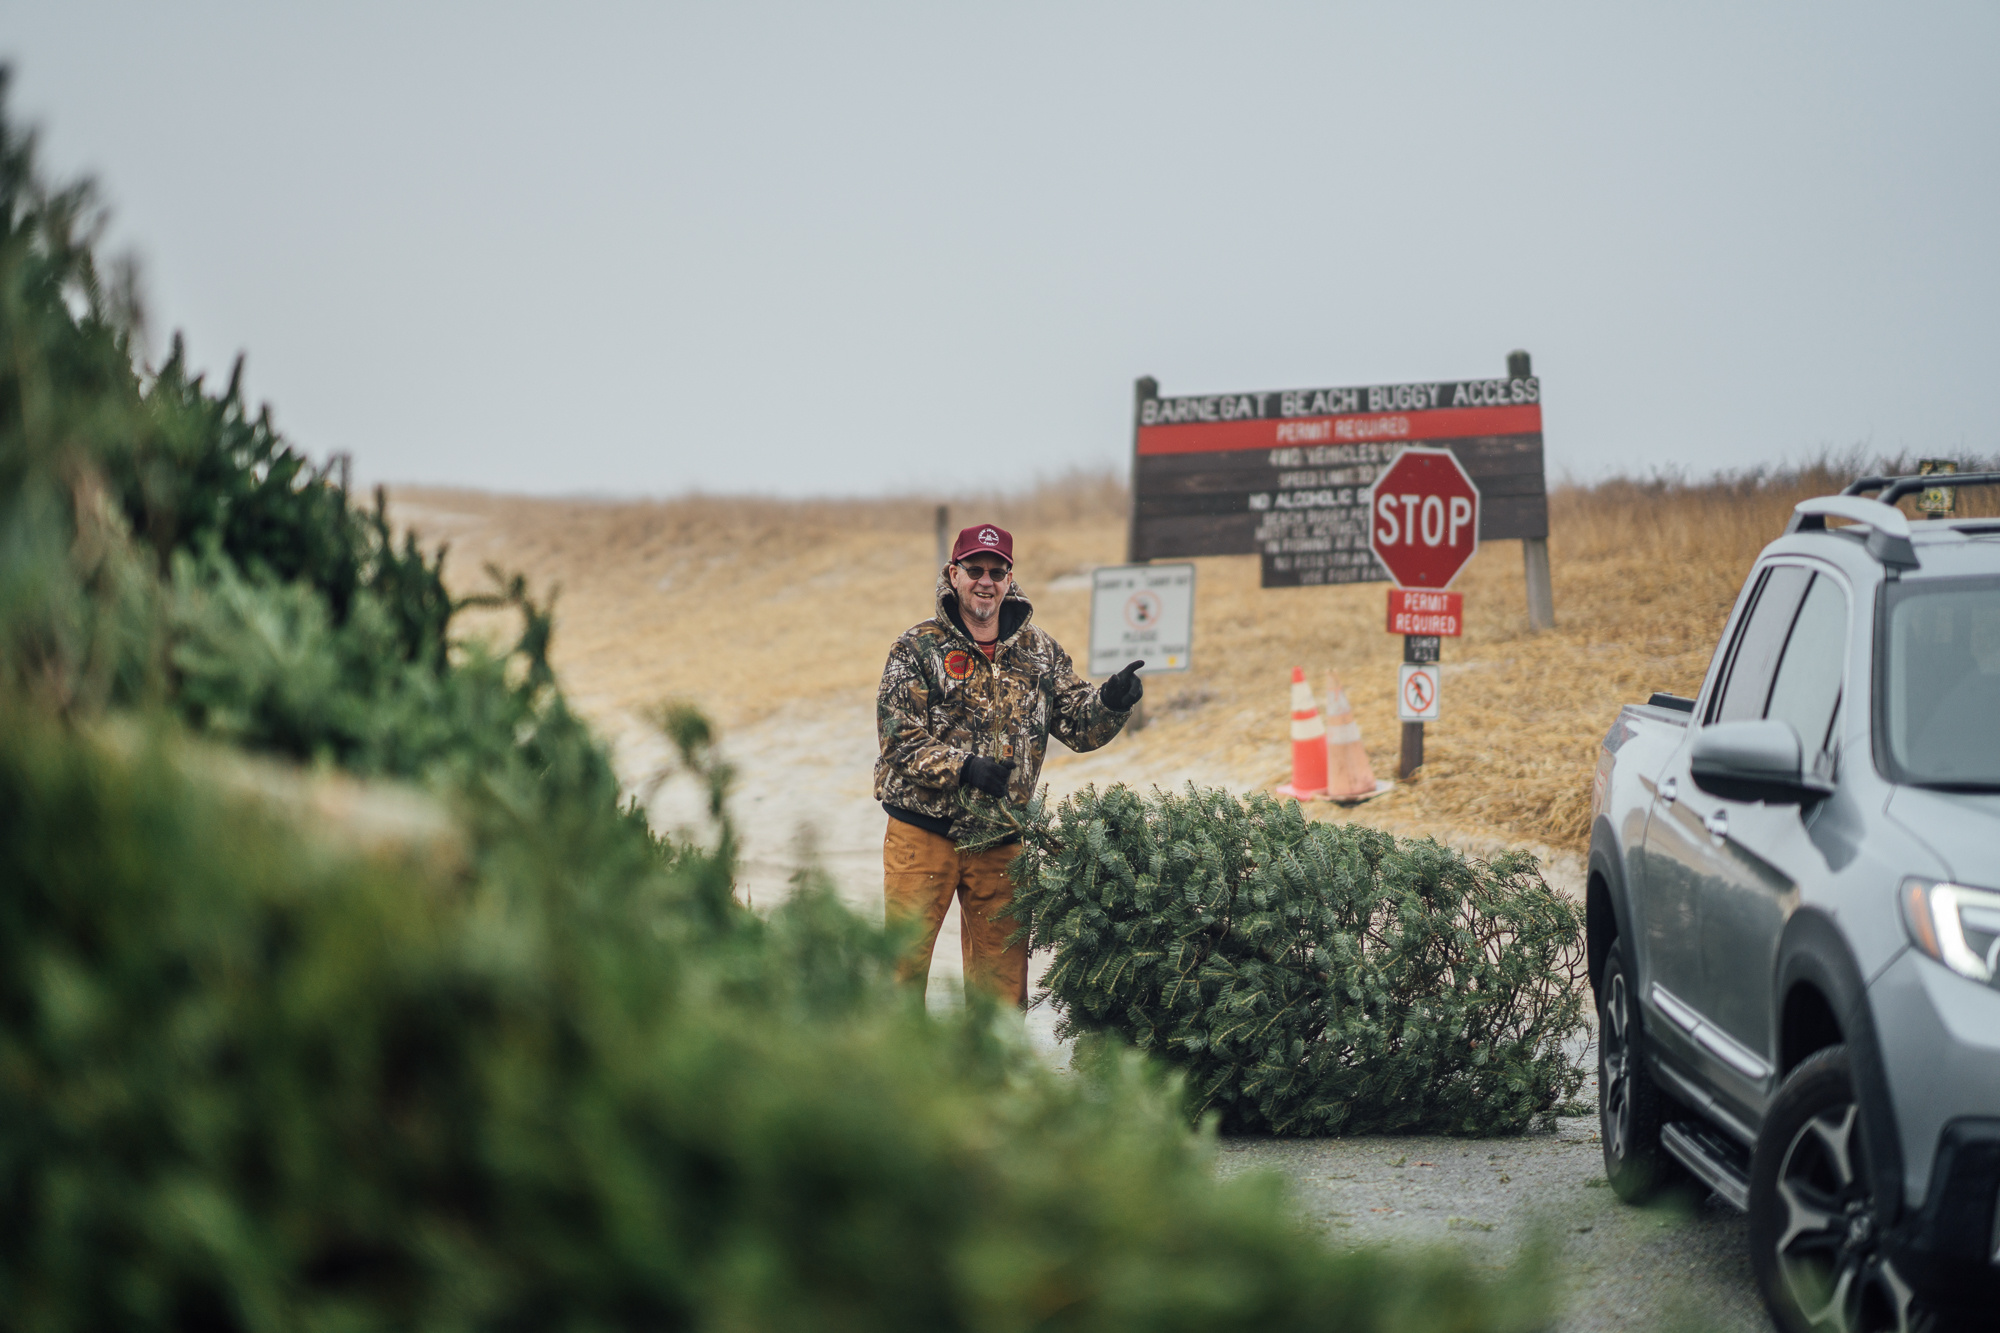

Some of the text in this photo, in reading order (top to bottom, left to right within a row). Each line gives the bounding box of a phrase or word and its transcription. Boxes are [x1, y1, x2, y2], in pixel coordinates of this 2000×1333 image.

[1141, 378, 1538, 425] BARNEGAT BEACH BUGGY ACCESS
[1276, 416, 1410, 443] PERMIT REQUIRED
[1268, 447, 1302, 467] 4WD
[1306, 443, 1379, 465] VEHICLES
[1278, 471, 1318, 488] SPEED
[1320, 468, 1355, 486] LIMIT
[1248, 493, 1270, 511] NO
[1274, 488, 1353, 509] ALCOHOLIC
[1262, 511, 1304, 526] BEACH
[1377, 493, 1471, 547] STOP
[1282, 536, 1331, 551] FISHING
[1404, 592, 1448, 611] PERMIT
[1395, 613, 1456, 634] REQUIRED
[1410, 636, 1438, 649] LOWER
